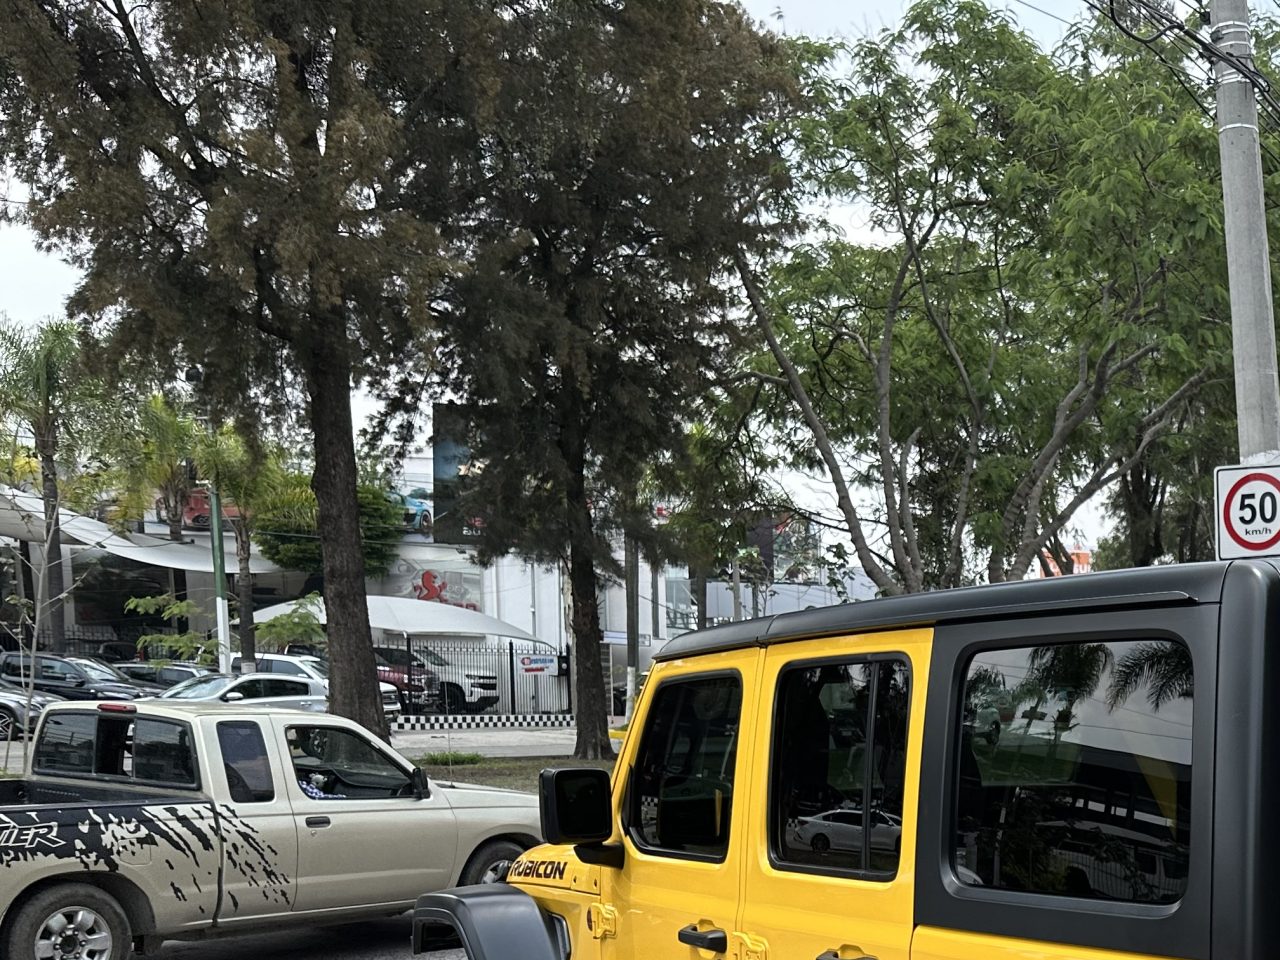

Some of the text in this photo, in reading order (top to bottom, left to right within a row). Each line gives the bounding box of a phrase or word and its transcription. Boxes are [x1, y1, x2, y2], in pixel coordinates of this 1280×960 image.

[1239, 491, 1277, 525] 50
[1245, 527, 1272, 535] km/h
[510, 860, 568, 880] RUBICON
